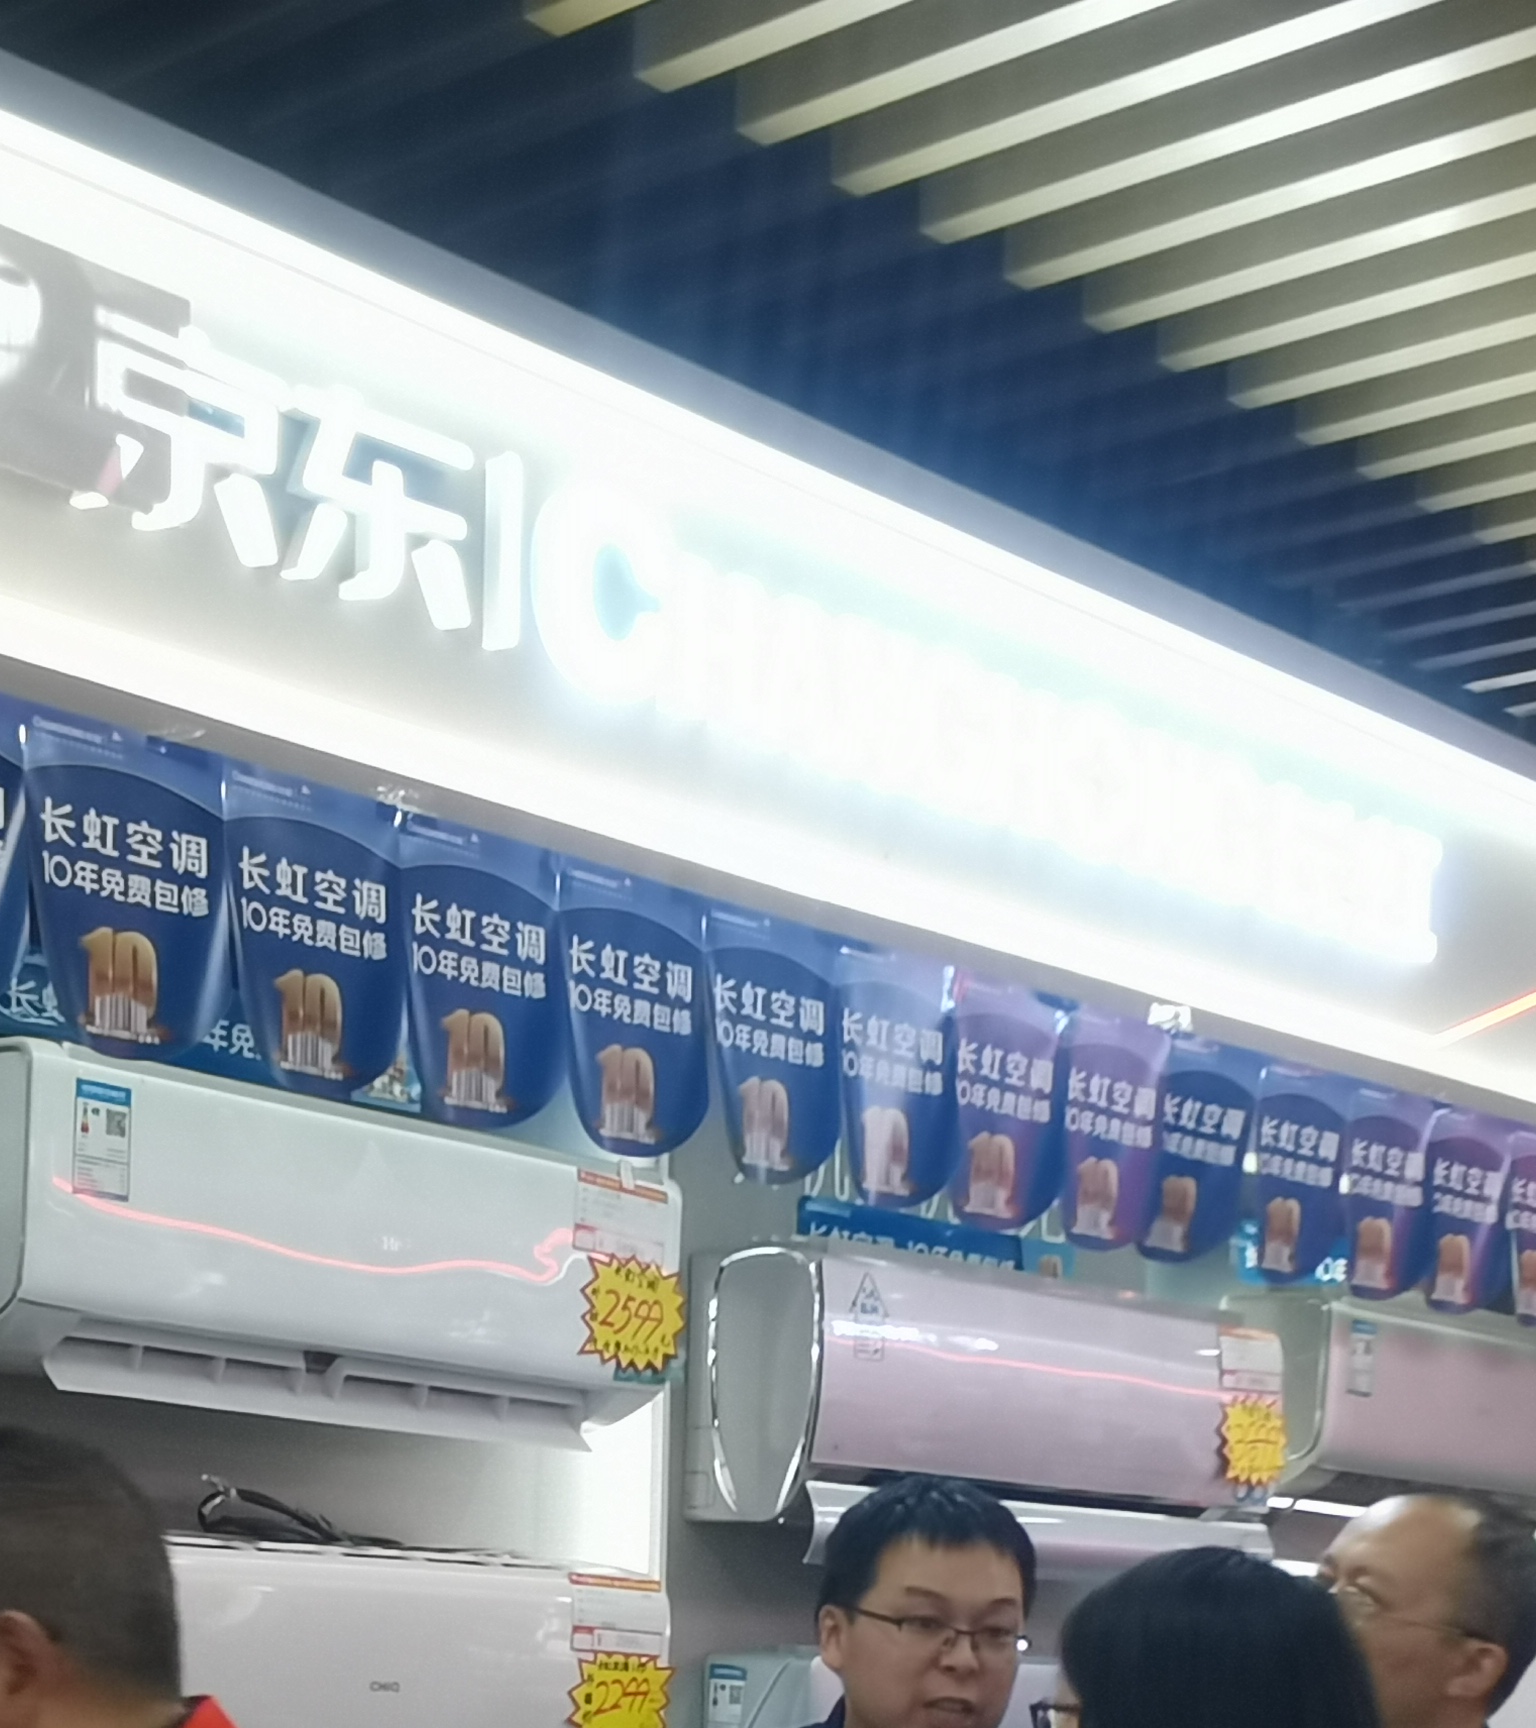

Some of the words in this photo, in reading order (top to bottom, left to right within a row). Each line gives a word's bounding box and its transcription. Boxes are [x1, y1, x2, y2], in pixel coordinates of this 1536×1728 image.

[68, 300, 476, 633] 京东
[39, 796, 209, 880] 长虹空调
[41, 849, 211, 919] 10年免费包修
[237, 846, 387, 926] 长虹空调
[239, 898, 389, 962] 10年免费包修
[409, 892, 548, 967] 长虹空调
[410, 944, 548, 1001] 10年免费包修
[567, 934, 694, 1004] 长虹空调
[567, 978, 694, 1037] 10年免费包修
[712, 973, 826, 1038] 长虹空调
[841, 1007, 944, 1068] 长虹空调
[956, 1036, 1055, 1094] 长虹空调
[1067, 1067, 1158, 1123] 长虹空调
